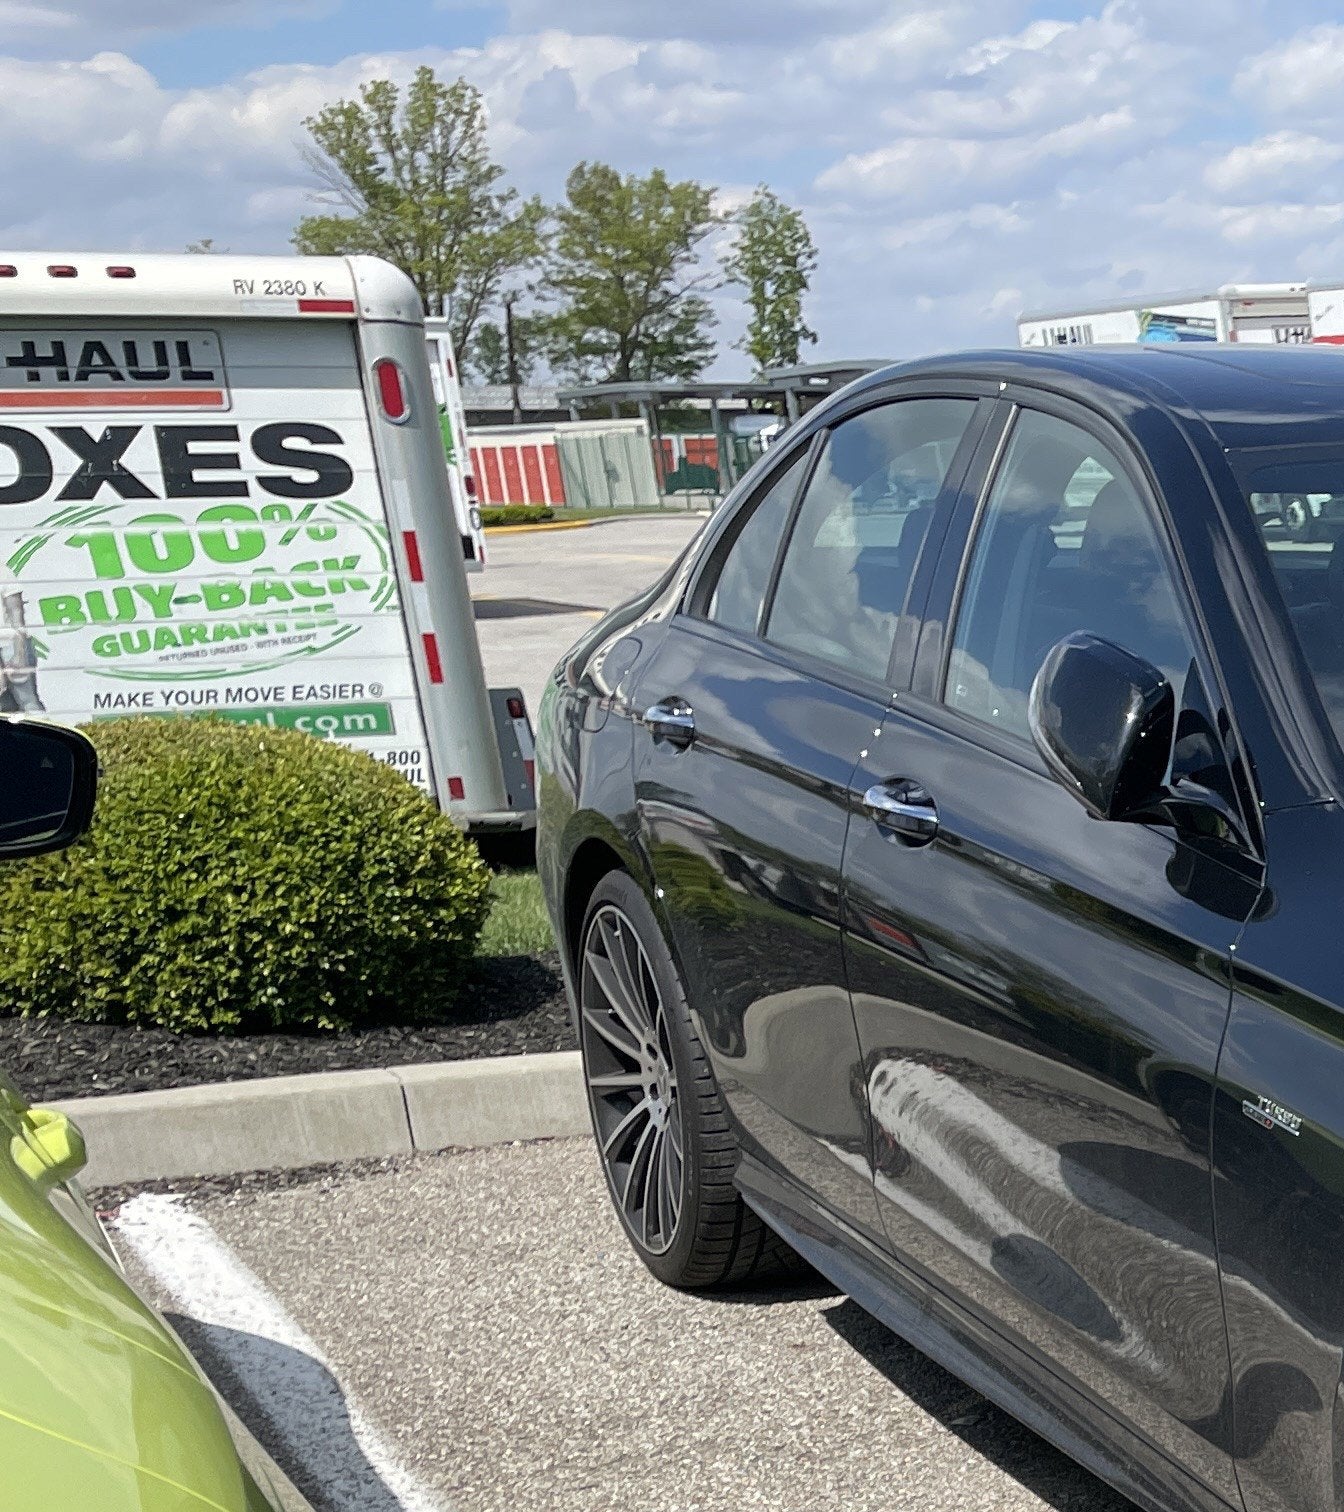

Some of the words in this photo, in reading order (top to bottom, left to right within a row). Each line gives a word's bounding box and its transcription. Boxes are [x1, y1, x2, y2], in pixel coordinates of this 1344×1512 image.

[233, 279, 254, 295] RV
[263, 280, 306, 296] 2380
[313, 281, 326, 296] K
[65, 502, 338, 580] 100%
[39, 555, 370, 634] BUY-BACK
[92, 603, 340, 658] GUARANTEE
[94, 692, 155, 709] MAKE
[160, 688, 219, 706] YOUR
[225, 686, 286, 703] MOVE
